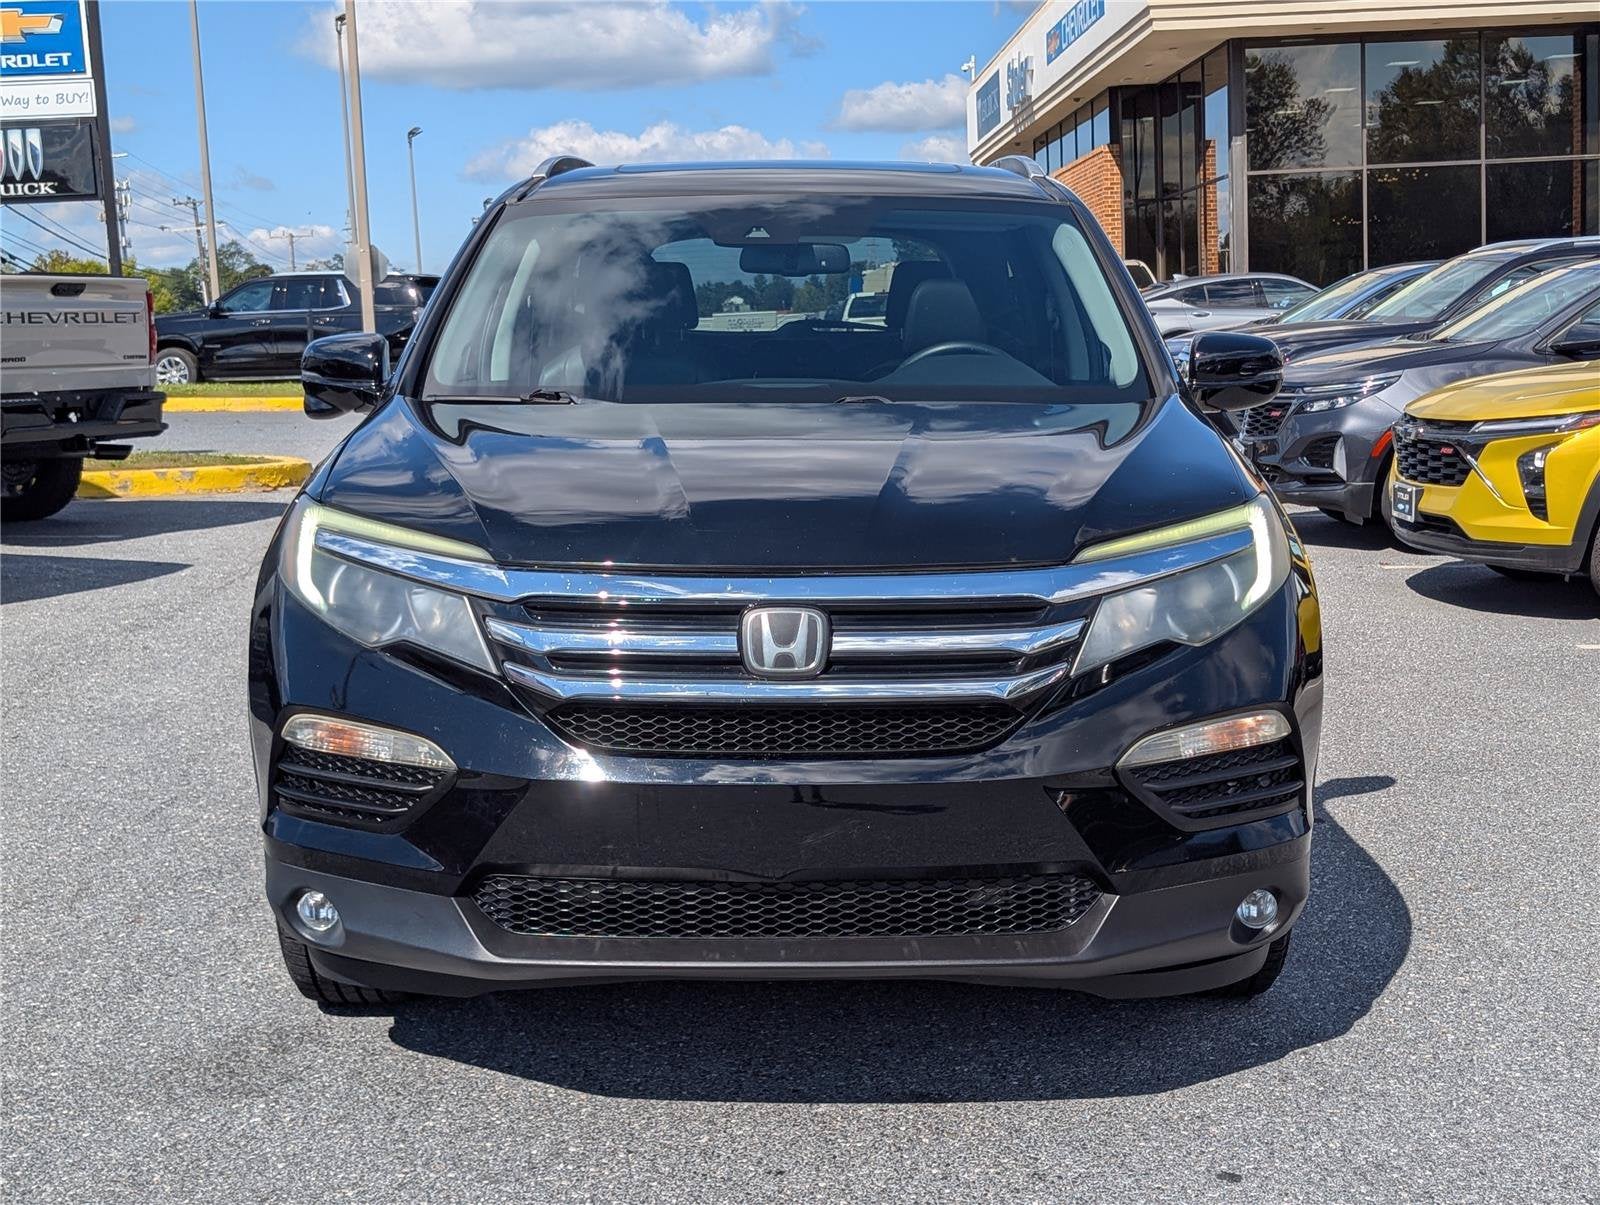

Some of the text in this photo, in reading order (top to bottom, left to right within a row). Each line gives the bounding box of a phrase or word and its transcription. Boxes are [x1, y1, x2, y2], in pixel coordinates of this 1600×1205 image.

[0, 92, 89, 109] Way to BUY!
[0, 311, 140, 324] HEVROLET
